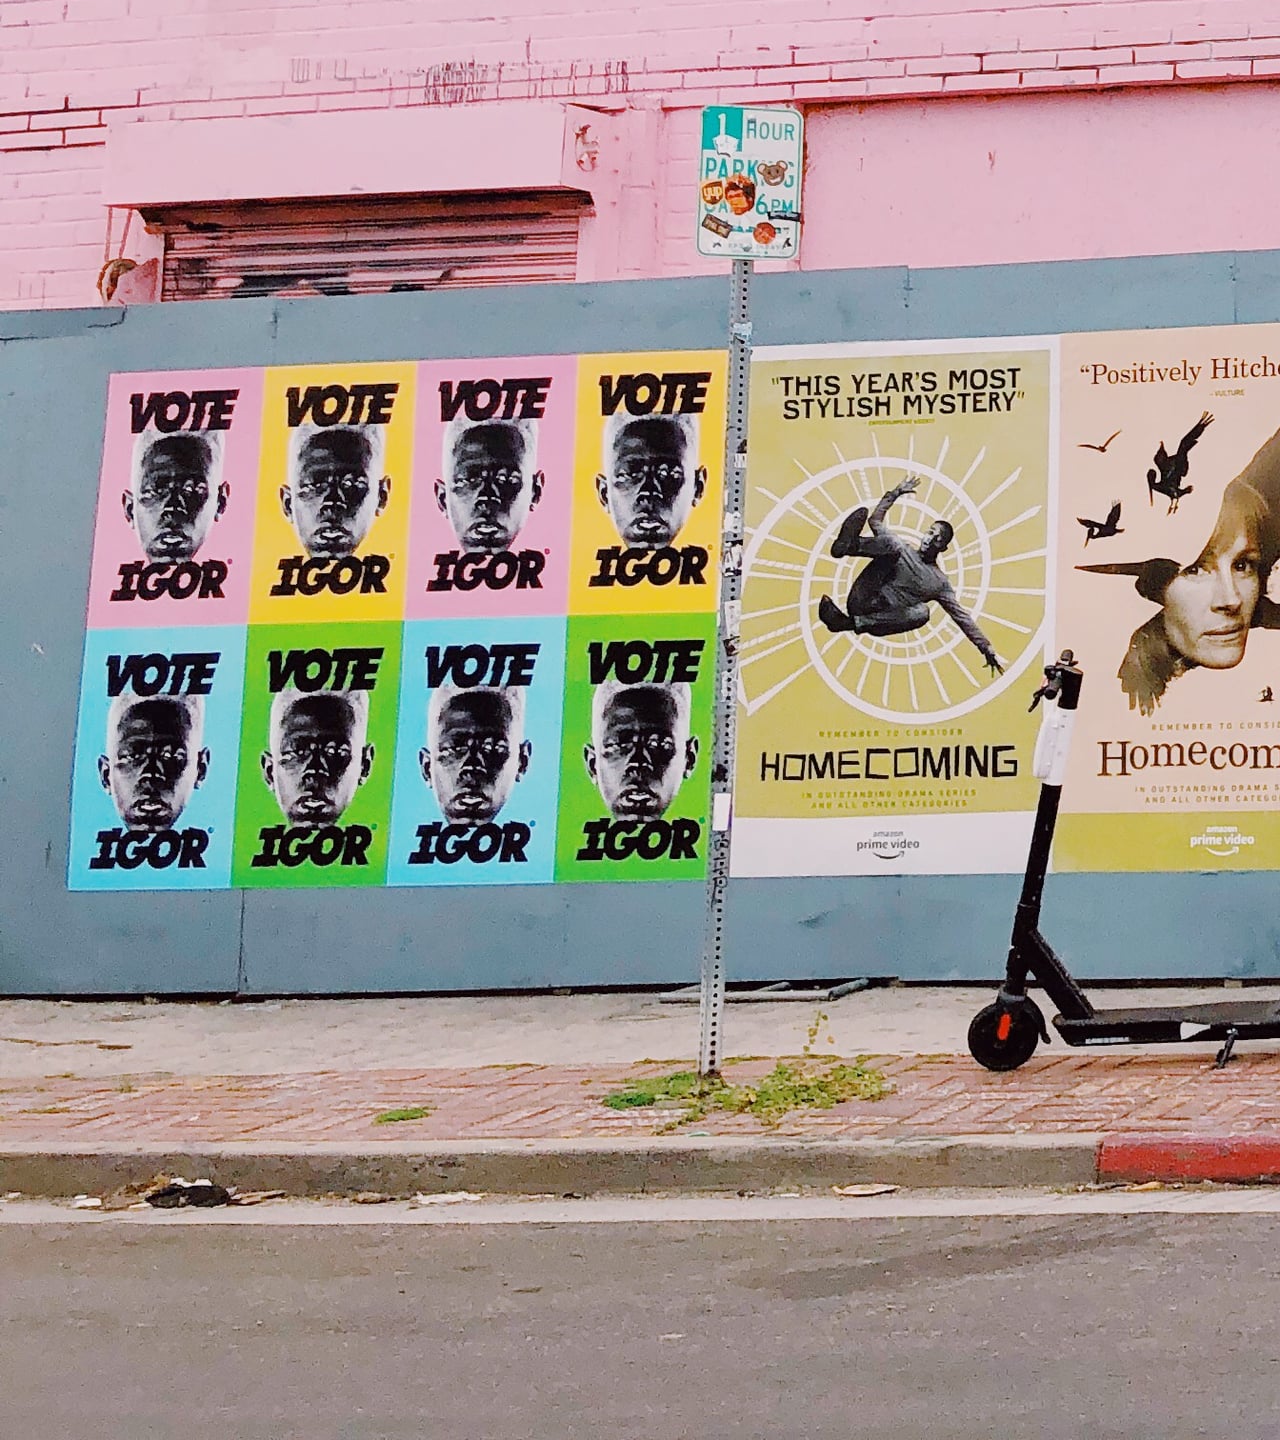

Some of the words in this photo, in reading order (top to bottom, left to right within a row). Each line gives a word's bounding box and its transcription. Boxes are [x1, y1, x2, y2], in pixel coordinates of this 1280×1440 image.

[746, 118, 795, 141] HOUR
[599, 372, 712, 416] VOTE
[771, 375, 840, 396] "THIS
[949, 368, 1021, 390] MOST
[1080, 360, 1202, 386] “Positively
[130, 389, 240, 434] VOTE
[286, 382, 399, 427] VOTE
[439, 377, 553, 422] VOTE
[783, 396, 891, 420] STYLISH
[903, 391, 1025, 415] MYSTERY"
[110, 558, 228, 602] IGOR
[270, 553, 390, 597] IGOR
[426, 550, 546, 592] IGOR
[588, 546, 708, 588] IGOR
[105, 652, 221, 696] VOTE
[267, 647, 385, 693] VOTE
[424, 643, 541, 689] VOTE
[587, 639, 705, 686] VOTE
[819, 729, 879, 738] REMEMBER
[886, 729, 900, 737] TO
[906, 728, 964, 736] CONSIDER
[1151, 723, 1213, 731] REMEMBER
[1219, 722, 1233, 730] TO
[760, 744, 1018, 781] HOMECOMING
[838, 800, 858, 808] ALL
[939, 788, 977, 797] SERIES
[1135, 785, 1146, 793] IN
[1151, 784, 1226, 793] OUTSTANDING
[1231, 784, 1268, 792] DRAMA
[1145, 796, 1166, 804] AND
[1171, 795, 1191, 803] ALL
[1196, 794, 1230, 803] OTHER
[89, 824, 209, 870] IGOR
[251, 824, 372, 868] IGOR
[408, 820, 531, 864] IGOR
[576, 817, 700, 860] IGOR
[856, 839, 889, 851] prime
[890, 839, 920, 849] video
[873, 830, 904, 838] amazon
[1190, 834, 1222, 848] prime
[1224, 834, 1255, 845] video
